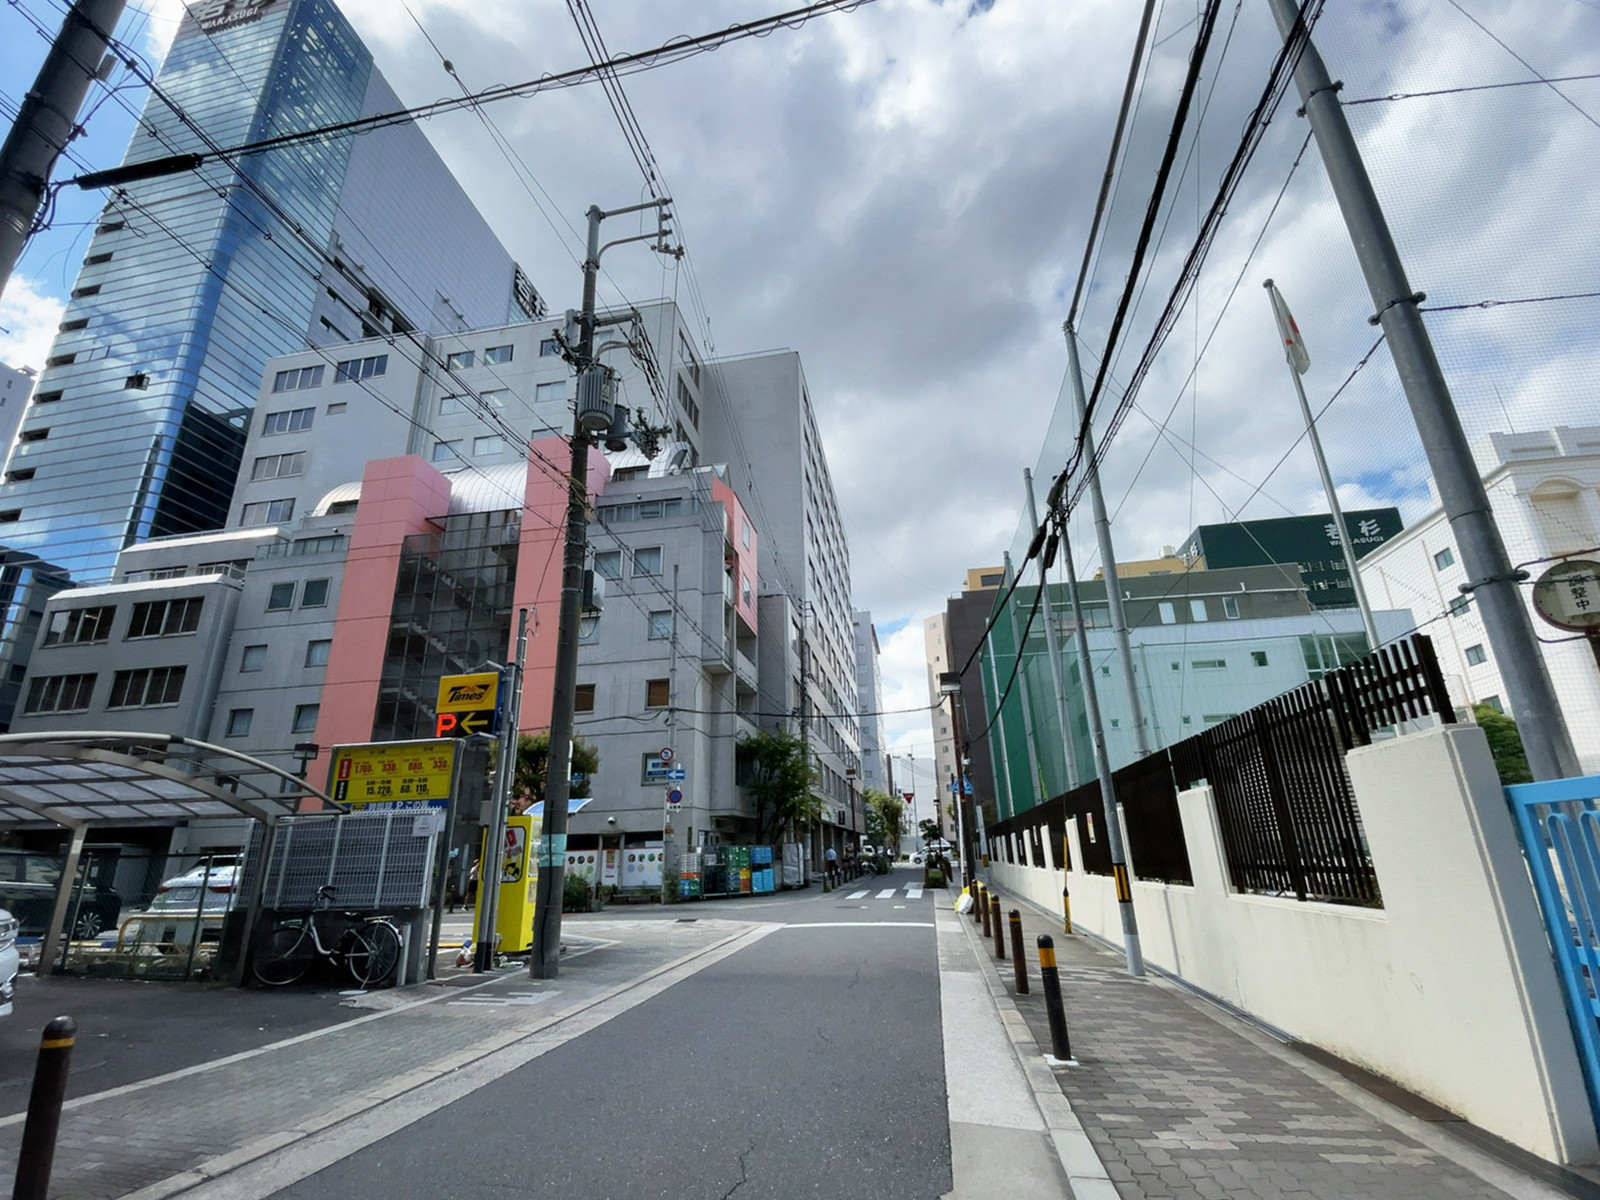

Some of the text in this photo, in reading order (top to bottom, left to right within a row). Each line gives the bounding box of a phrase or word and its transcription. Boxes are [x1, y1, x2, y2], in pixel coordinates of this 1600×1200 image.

[201, 7, 259, 30] WAKASUGI
[448, 684, 490, 703] Times
[436, 713, 457, 738] P
